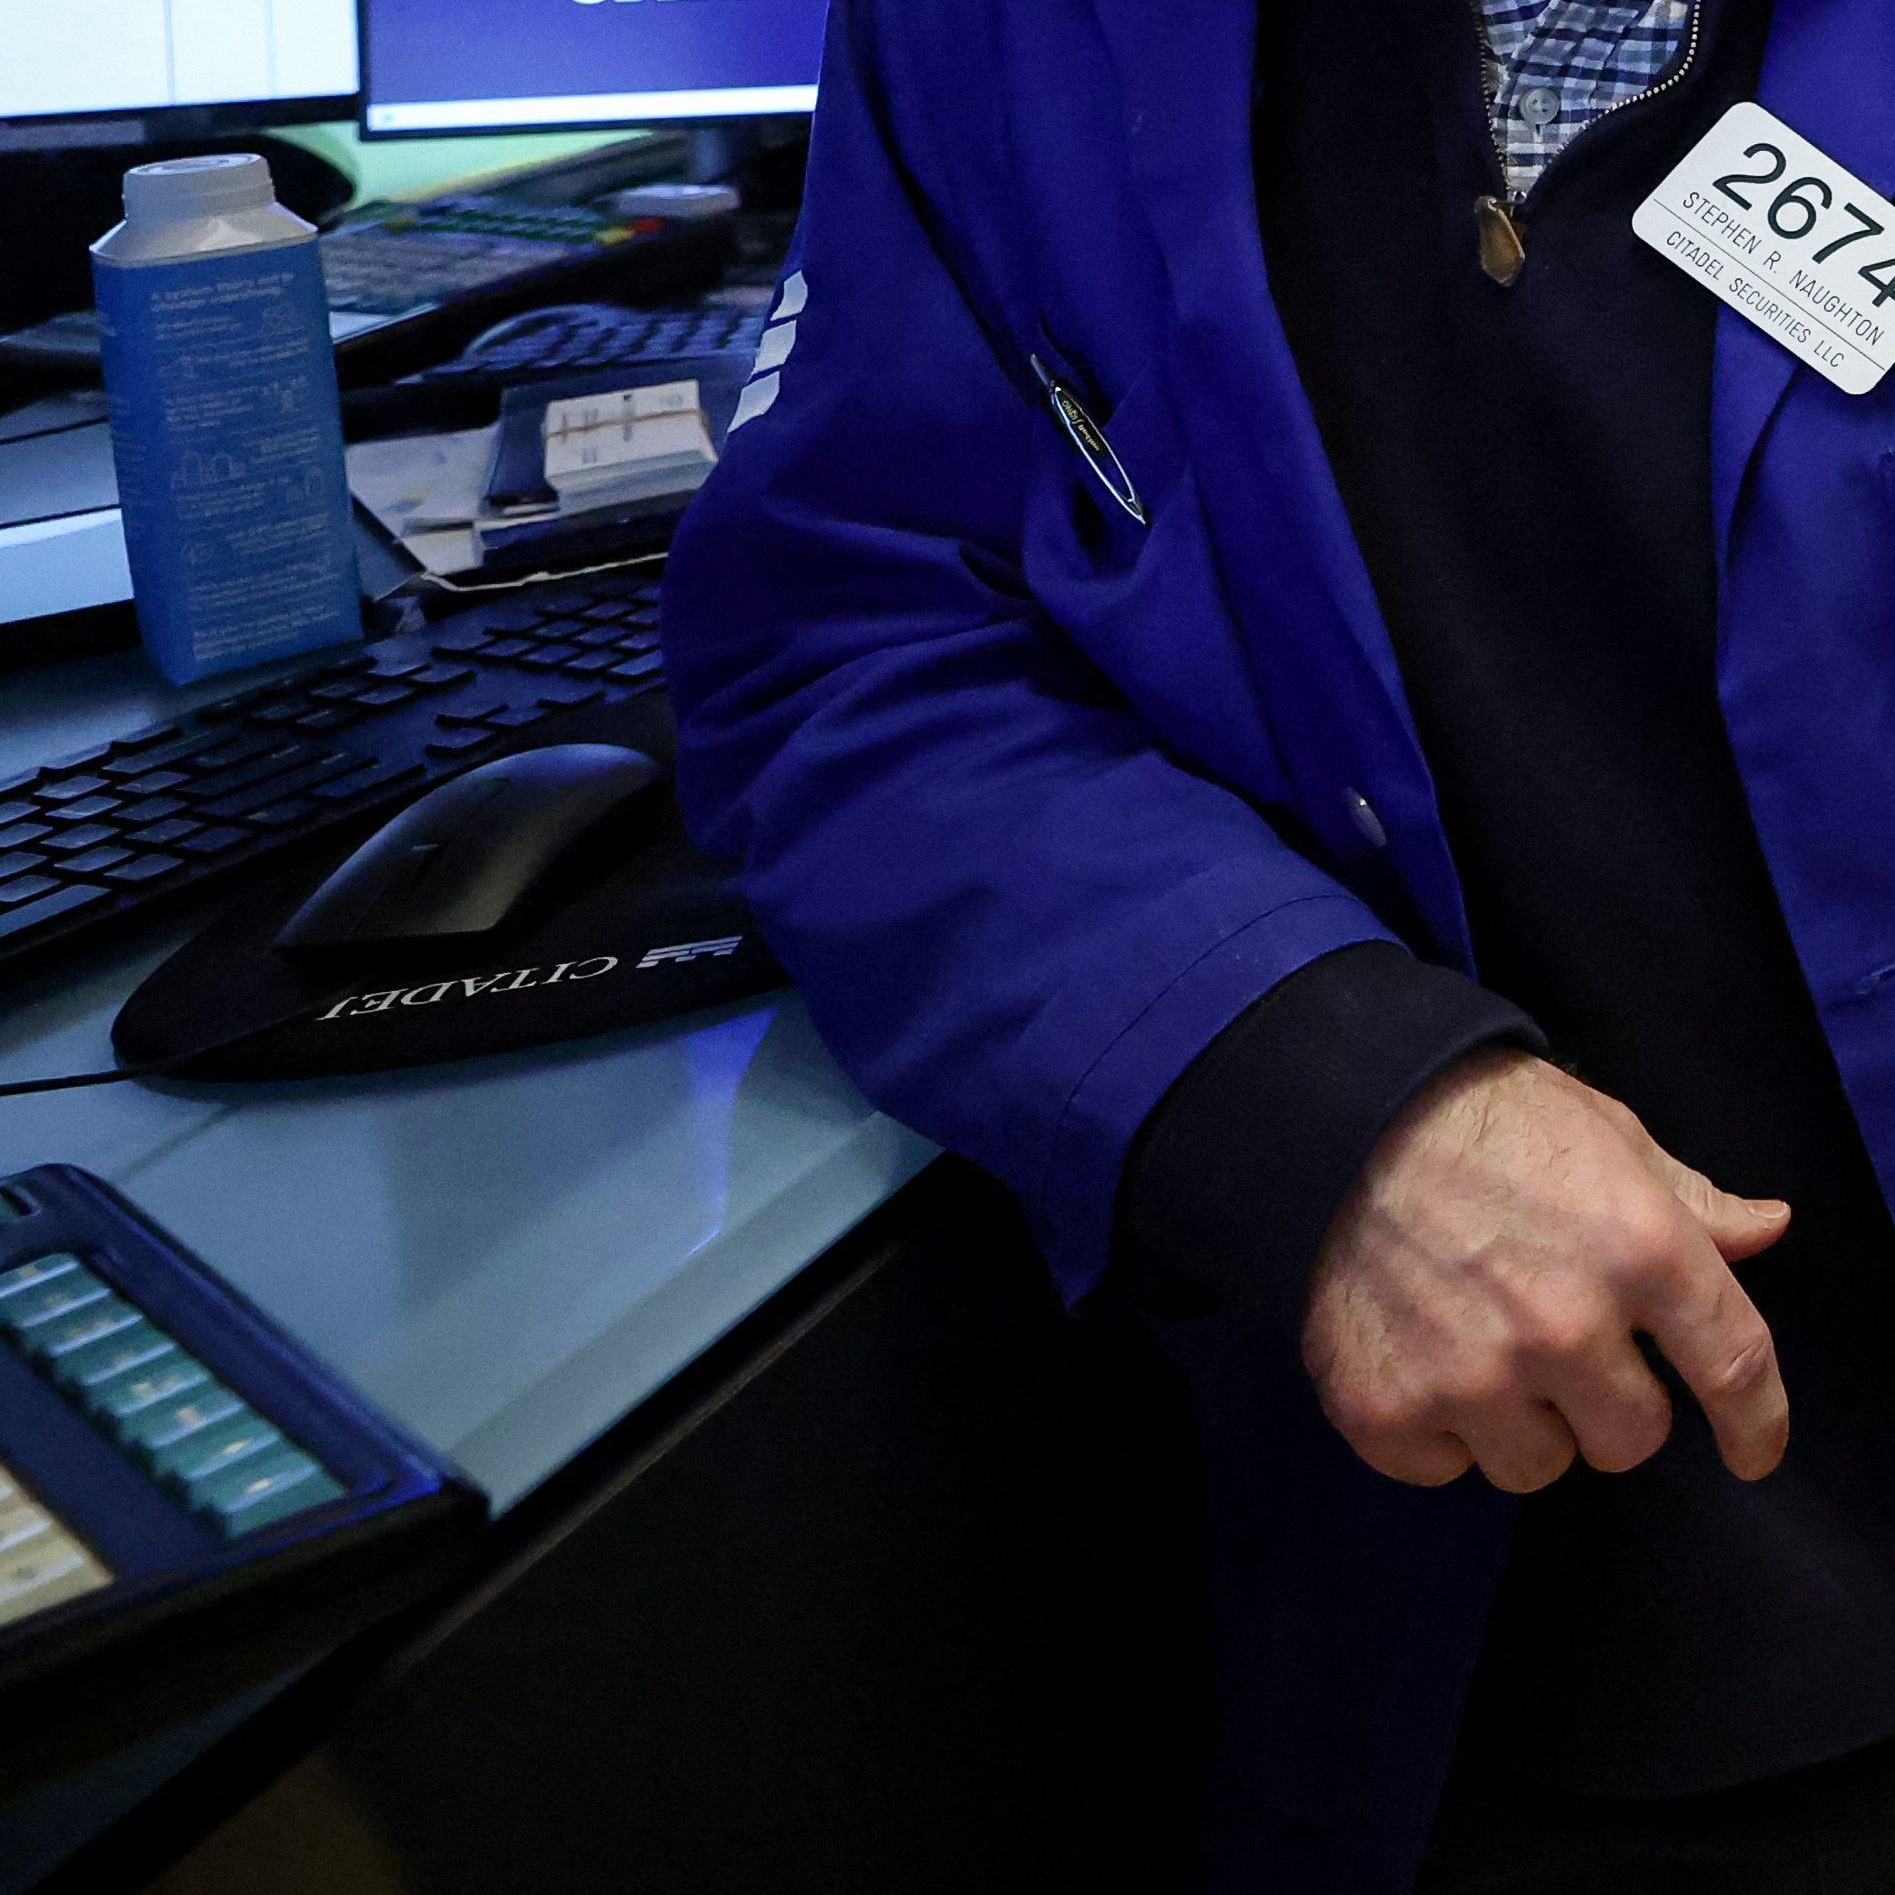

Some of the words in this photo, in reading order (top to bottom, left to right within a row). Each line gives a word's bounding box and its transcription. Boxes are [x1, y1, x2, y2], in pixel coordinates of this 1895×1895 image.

[1666, 230, 1725, 282] CITADEL
[1728, 277, 1812, 344] SECURITIES
[1813, 339, 1845, 368] LLC
[1682, 191, 1762, 255] STEPHEN
[1762, 250, 1783, 274] R.
[1788, 269, 1885, 347] NAUGHTON
